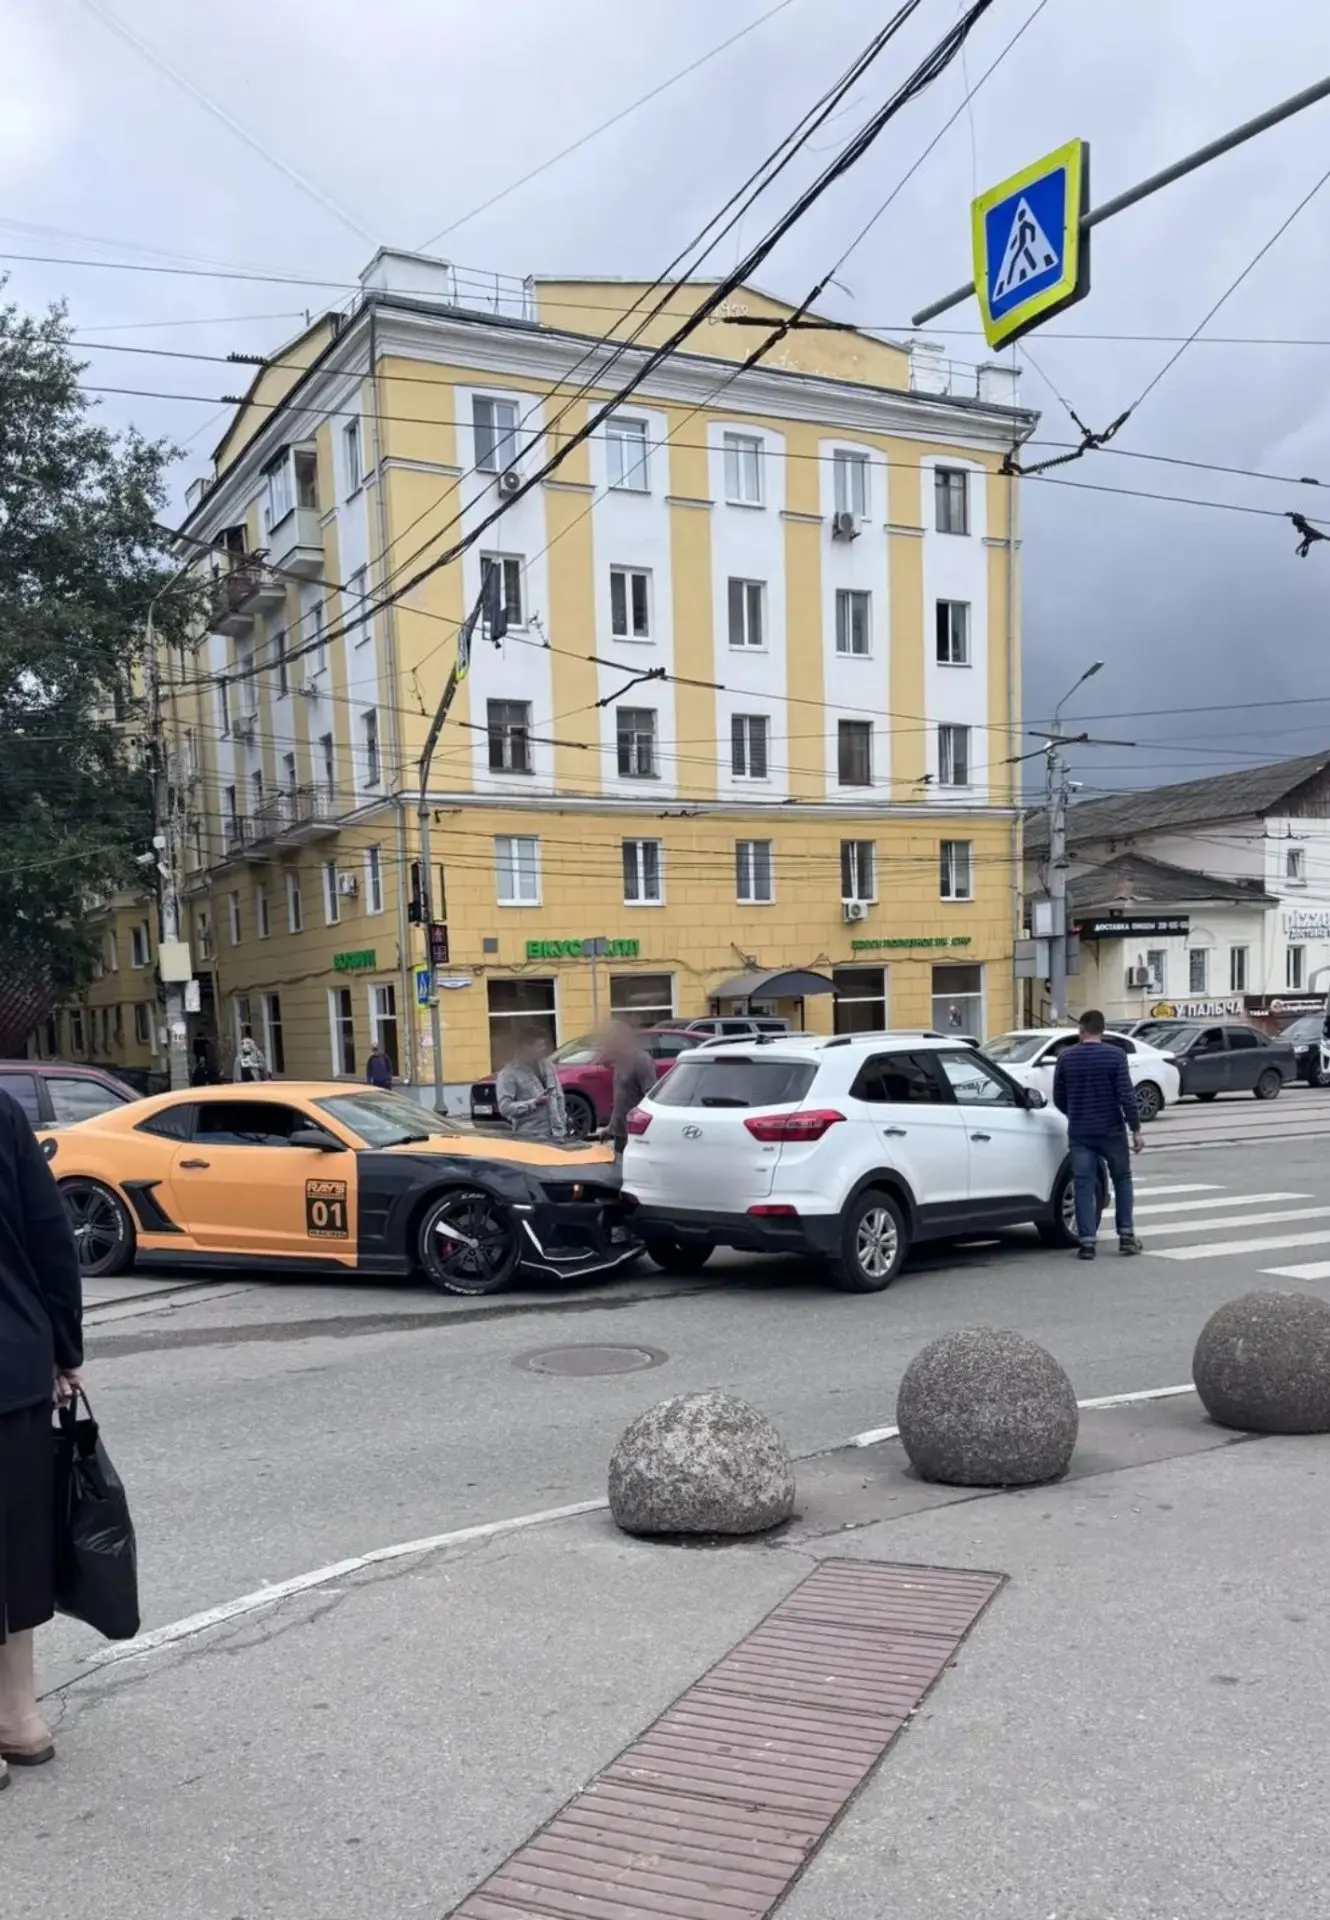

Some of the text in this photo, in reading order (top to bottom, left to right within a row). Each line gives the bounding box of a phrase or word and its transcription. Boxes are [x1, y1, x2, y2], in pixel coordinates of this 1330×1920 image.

[526, 938, 638, 958] ВКУСЛЛ
[1188, 1002, 1243, 1017] ПАЛЫЧА
[312, 1201, 342, 1228] 01
